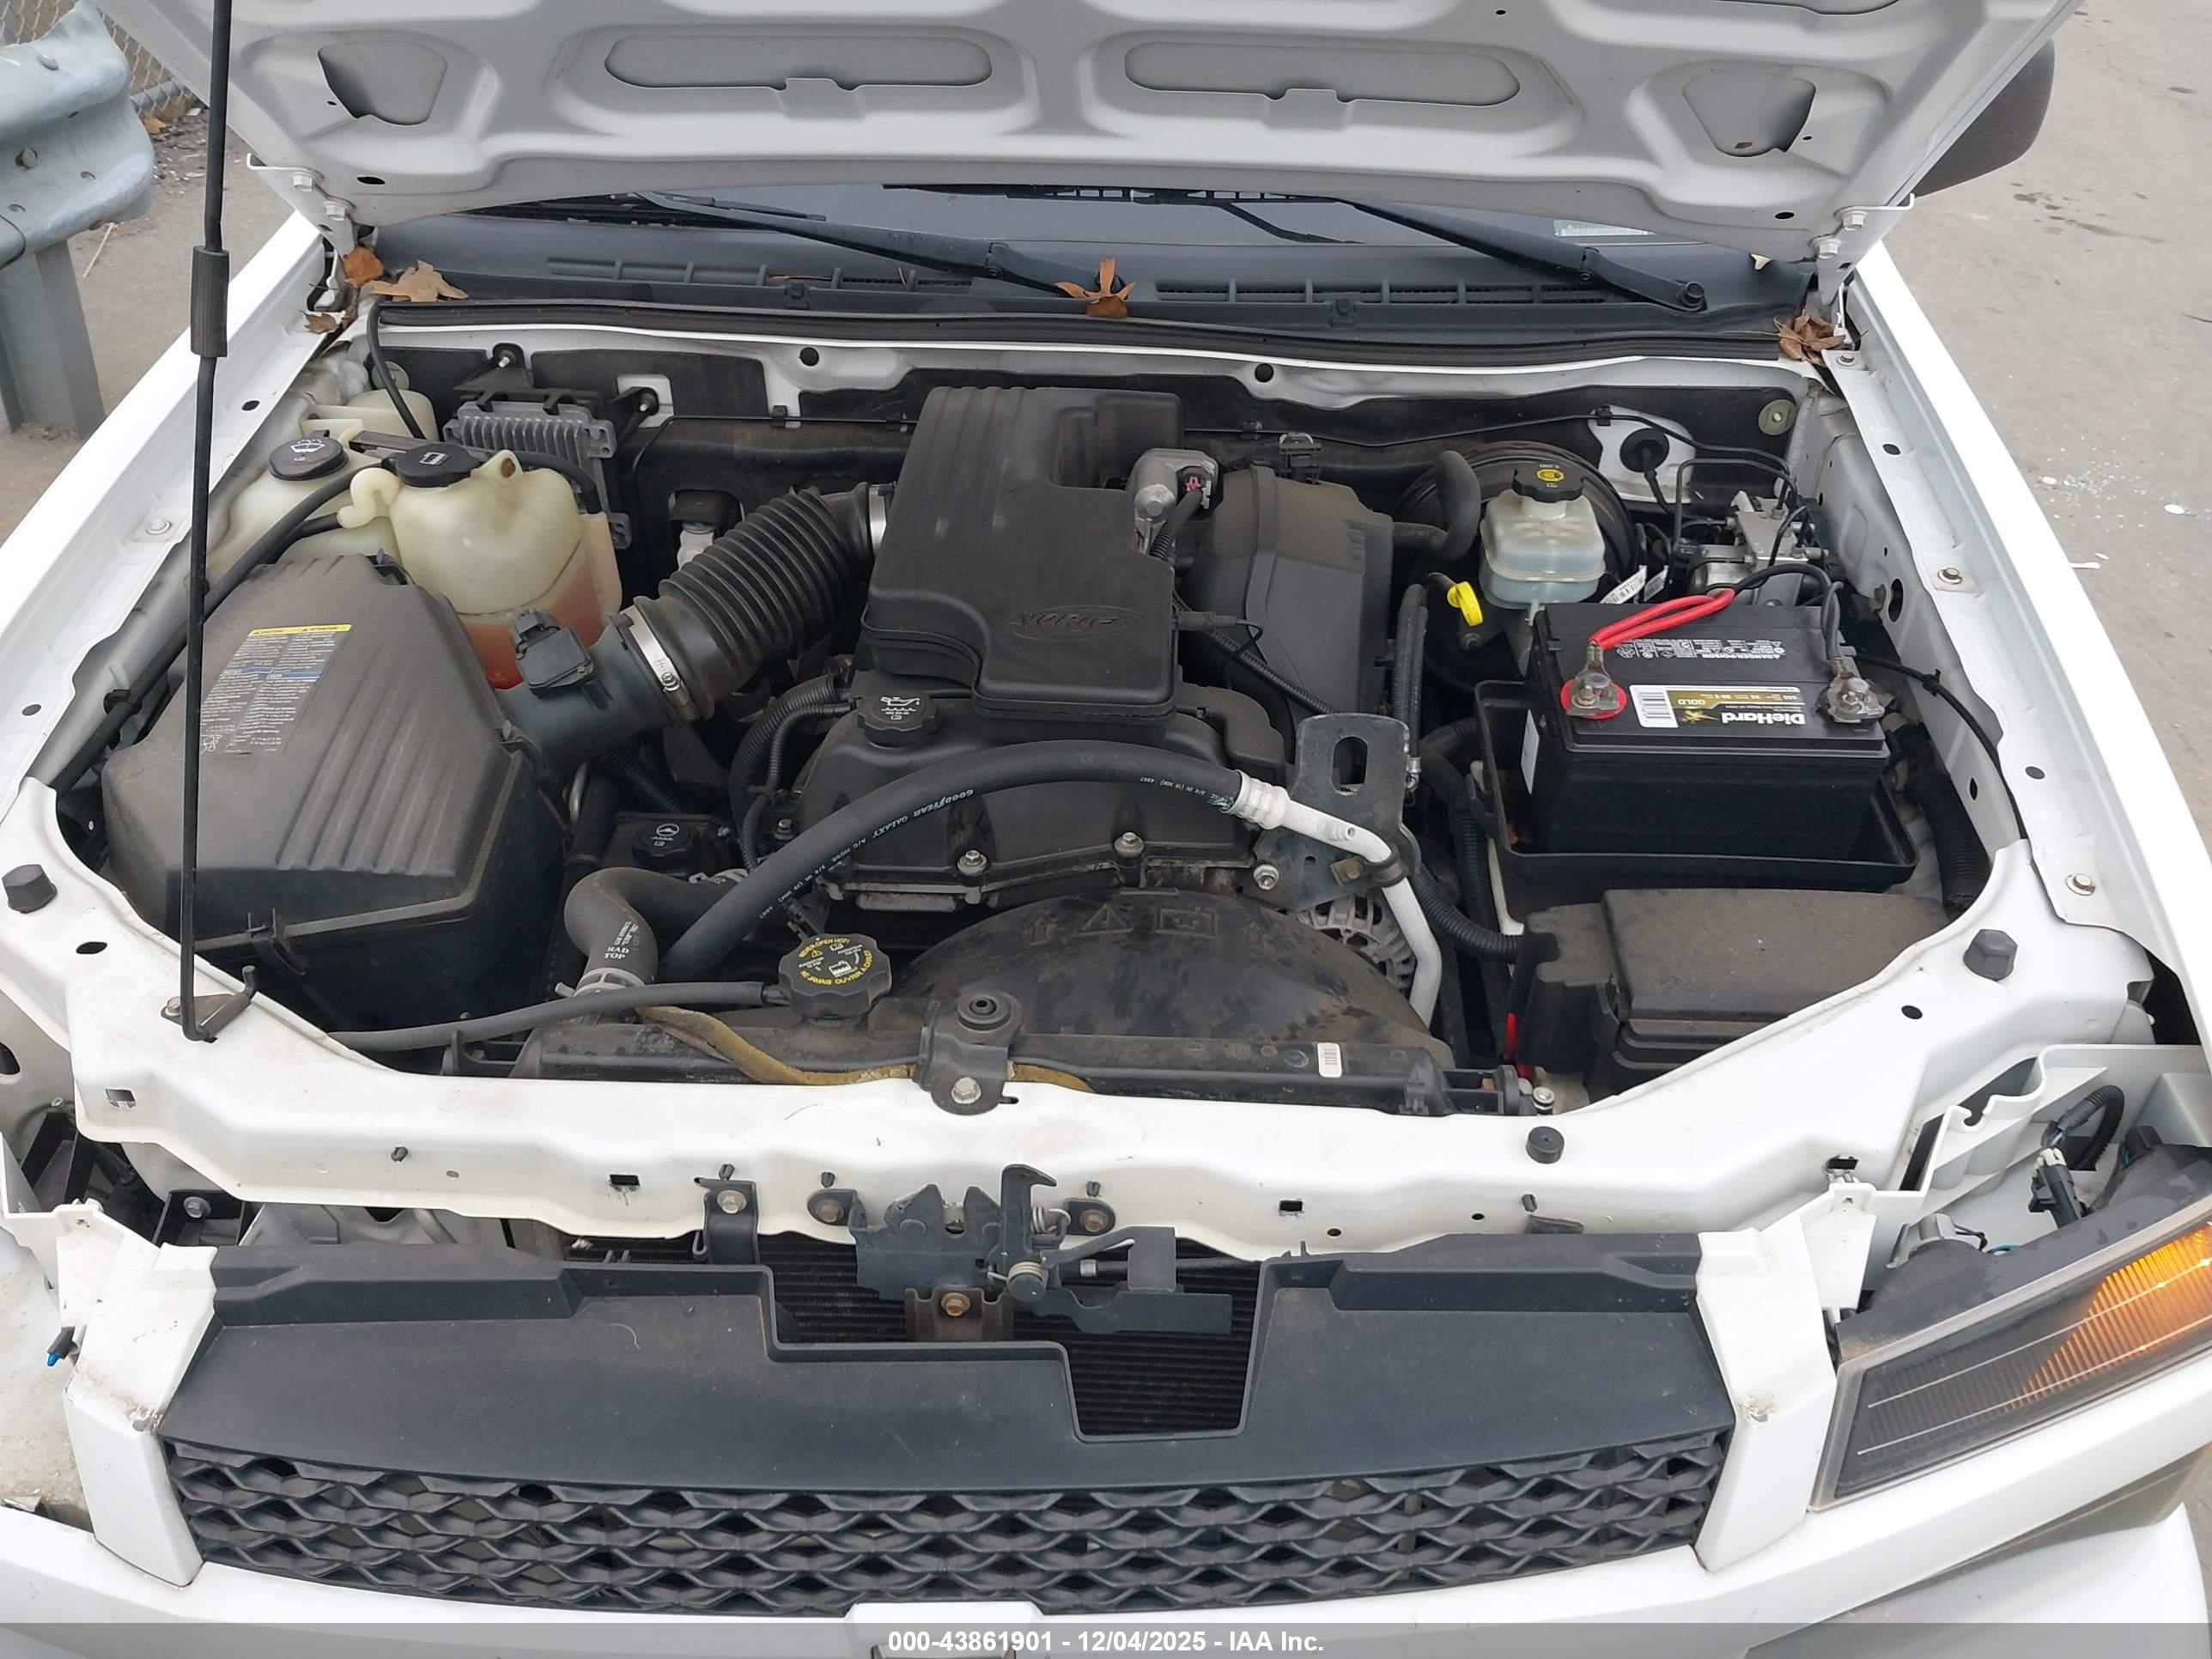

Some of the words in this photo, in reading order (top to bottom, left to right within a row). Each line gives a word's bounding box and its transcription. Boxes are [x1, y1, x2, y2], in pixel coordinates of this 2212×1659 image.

[1721, 712, 1806, 725] DieHard
[914, 789, 974, 817] GOODYEAR
[872, 816, 908, 839] GALAXY
[831, 848, 851, 862] HOSE
[607, 945, 630, 954] RAD
